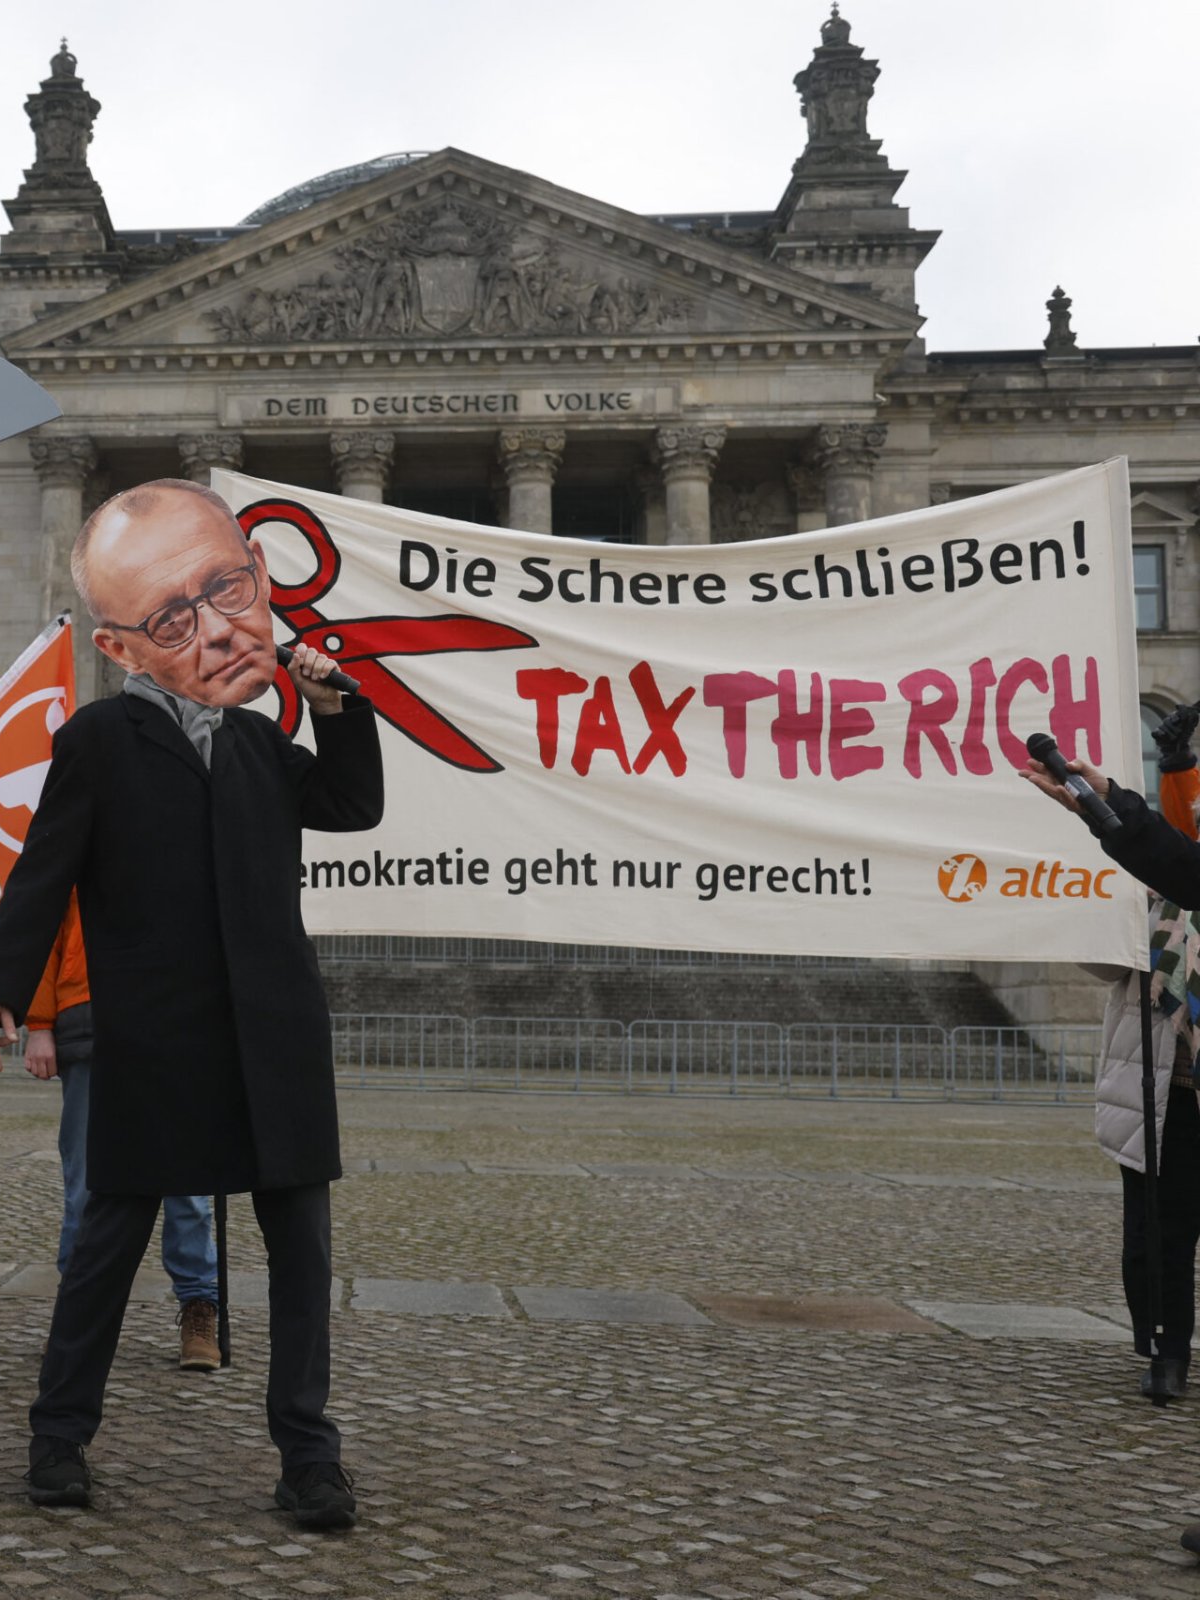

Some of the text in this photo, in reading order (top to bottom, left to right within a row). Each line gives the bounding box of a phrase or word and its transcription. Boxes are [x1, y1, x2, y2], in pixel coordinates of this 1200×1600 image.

[264, 392, 632, 417] DEM DEUTSCHEN VOLKE
[400, 520, 1090, 605] Die Schere schließen!
[516, 653, 1102, 781] TAX THE RICH
[504, 848, 598, 895] geht
[613, 860, 682, 889] nur
[695, 858, 872, 901] gerecht!
[999, 860, 1117, 899] attac
